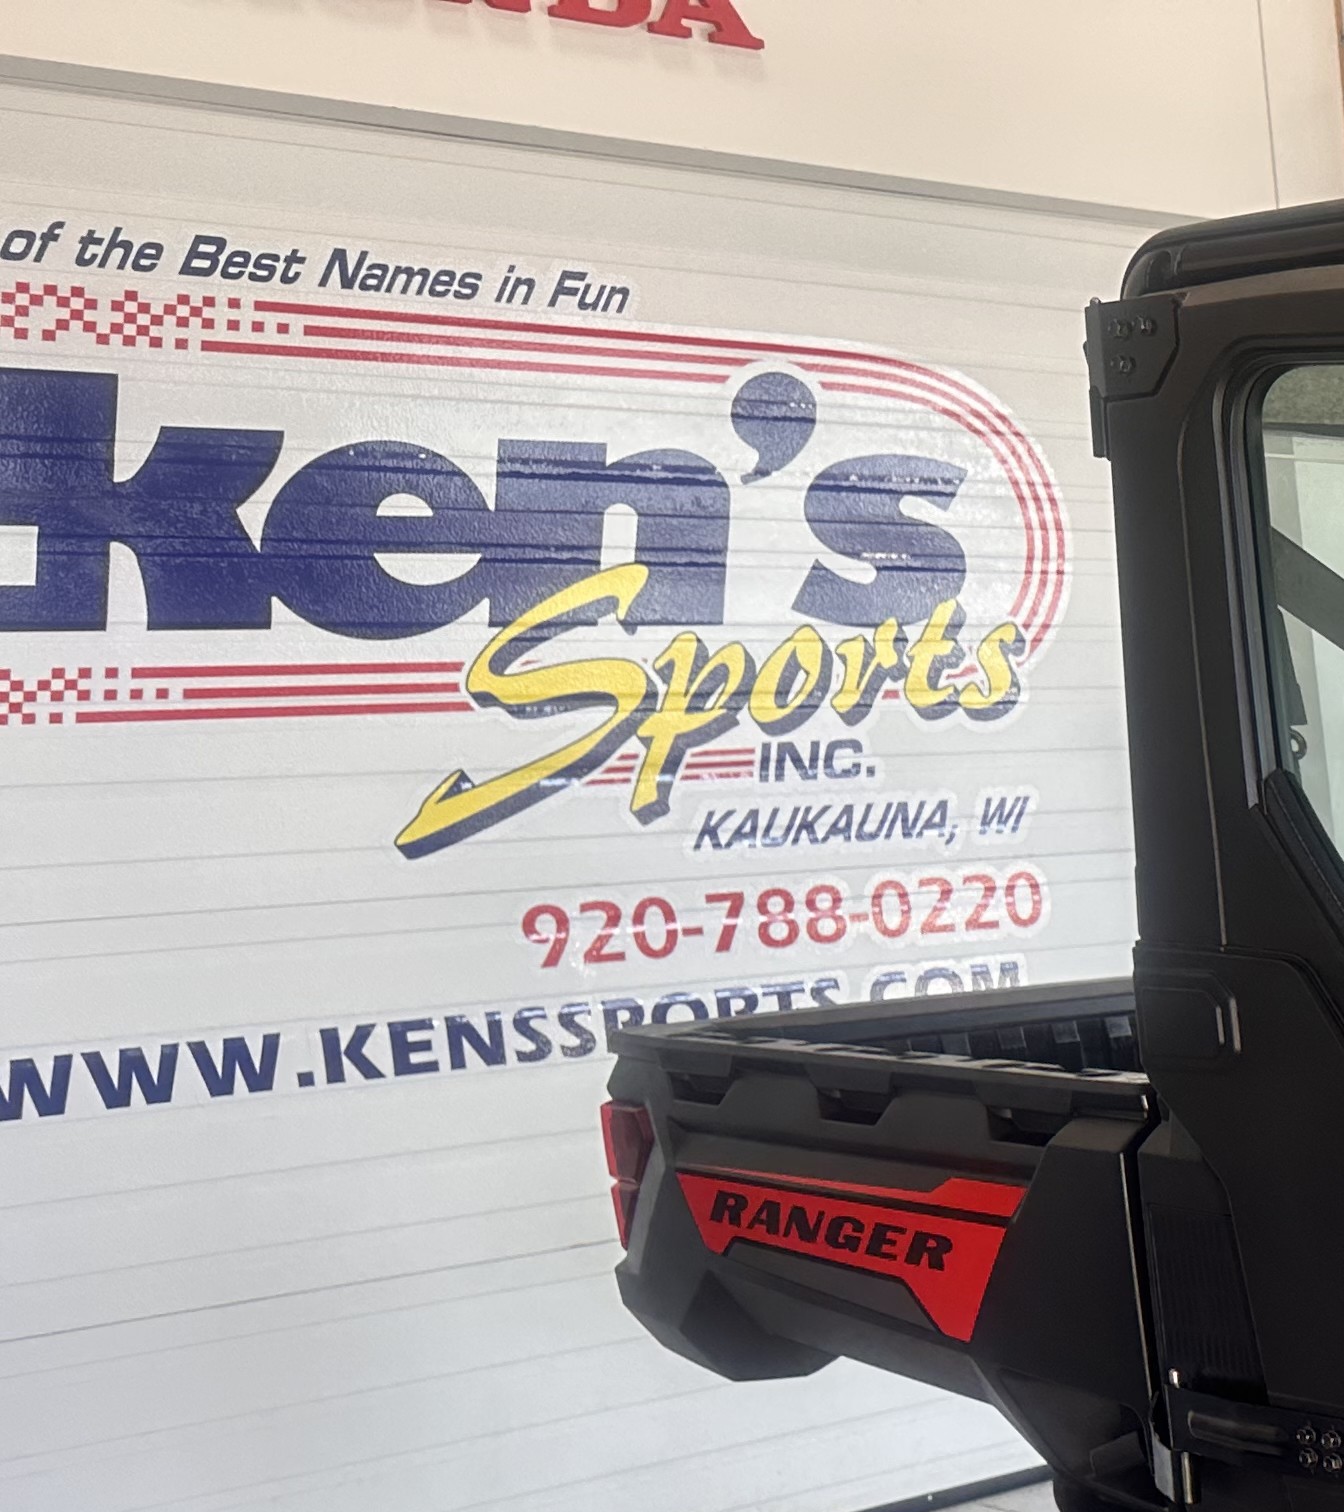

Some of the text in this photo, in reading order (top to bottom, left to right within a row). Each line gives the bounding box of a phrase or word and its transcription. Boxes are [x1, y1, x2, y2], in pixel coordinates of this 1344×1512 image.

[0, 221, 631, 314] of the Best Names in Fun
[392, 562, 1029, 860] Sports
[757, 739, 877, 783] INC.
[692, 796, 1029, 852] KAUKAUNA, WI
[521, 871, 1044, 969] 920-788-0220
[709, 1189, 954, 1272] RANGER
